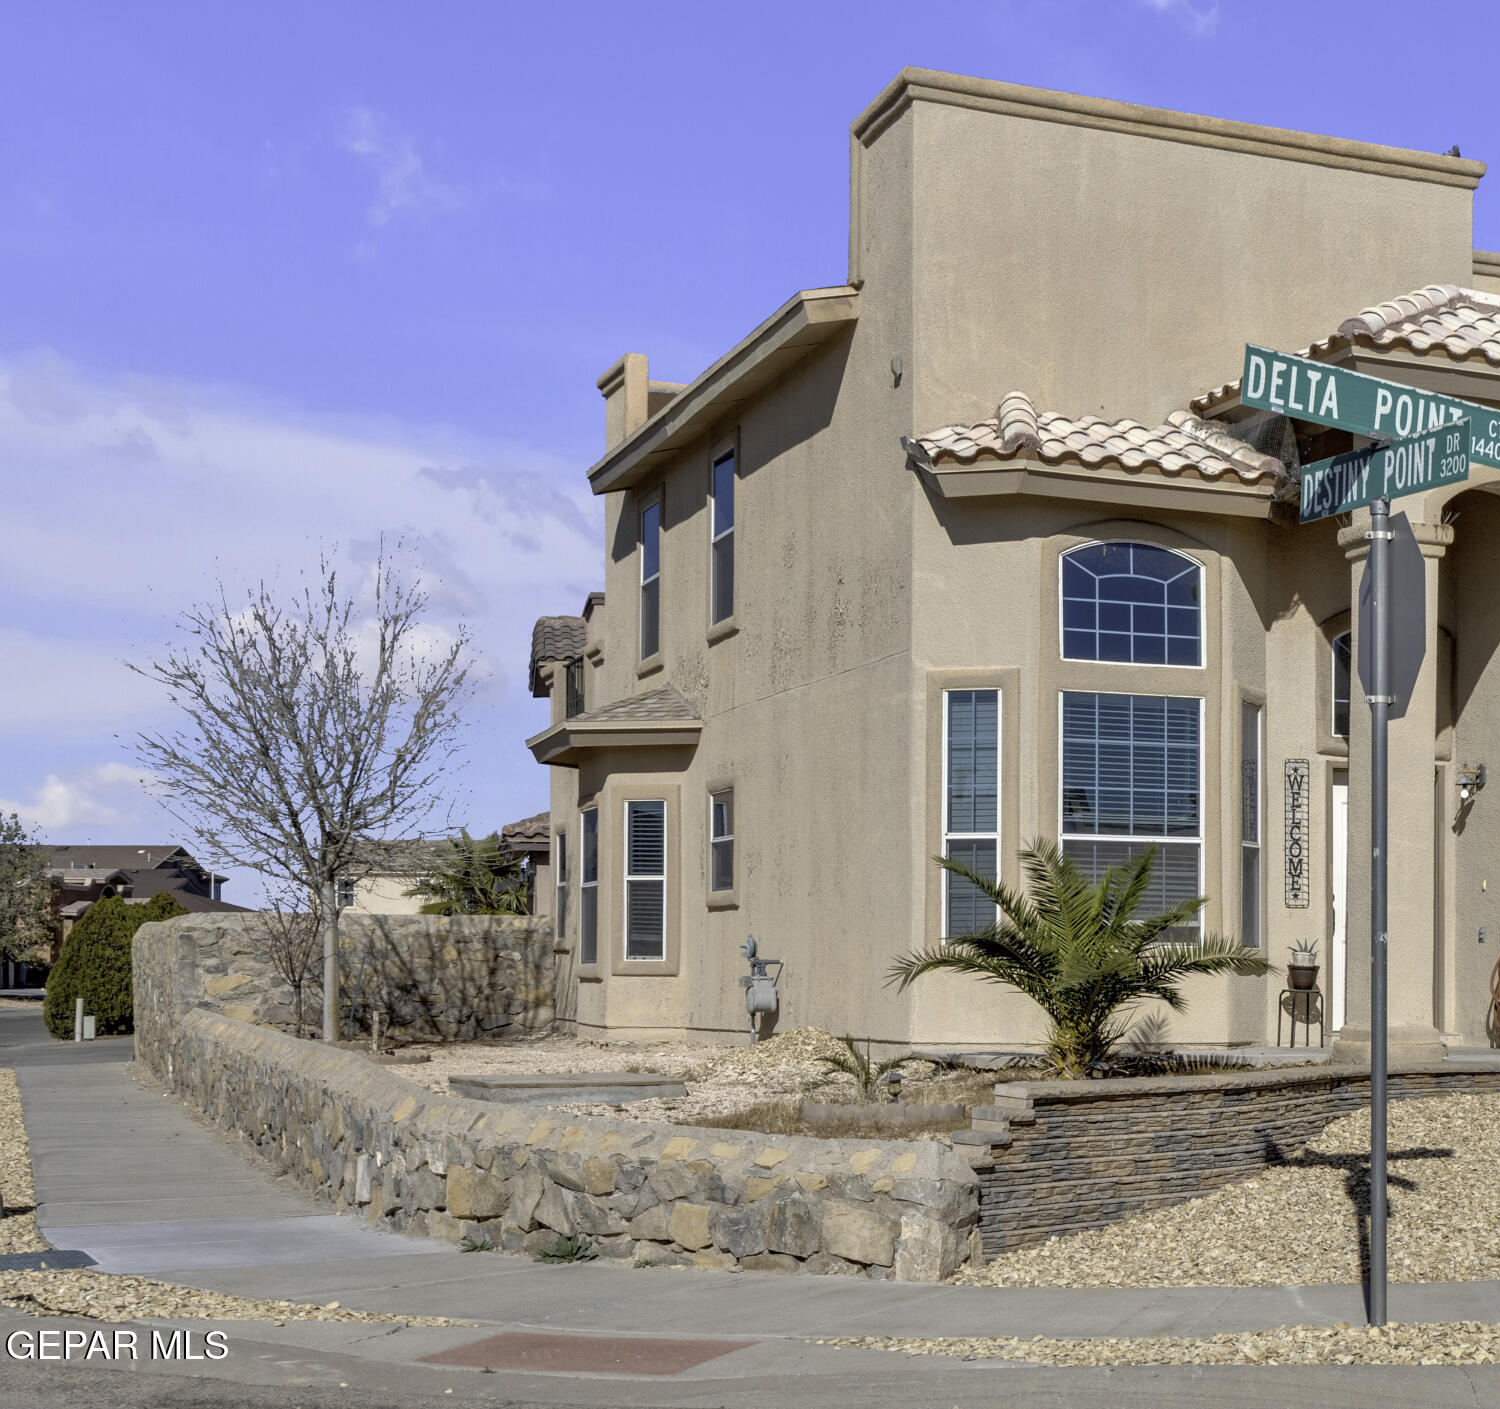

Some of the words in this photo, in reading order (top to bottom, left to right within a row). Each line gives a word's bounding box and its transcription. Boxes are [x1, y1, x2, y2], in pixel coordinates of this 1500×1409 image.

[1247, 354, 1339, 420] DELTA
[1440, 453, 1466, 478] 3200
[1446, 432, 1461, 454] DR
[1303, 455, 1370, 518] DESTINY
[1383, 437, 1436, 494] POINT
[1287, 774, 1304, 891] WELCOME
